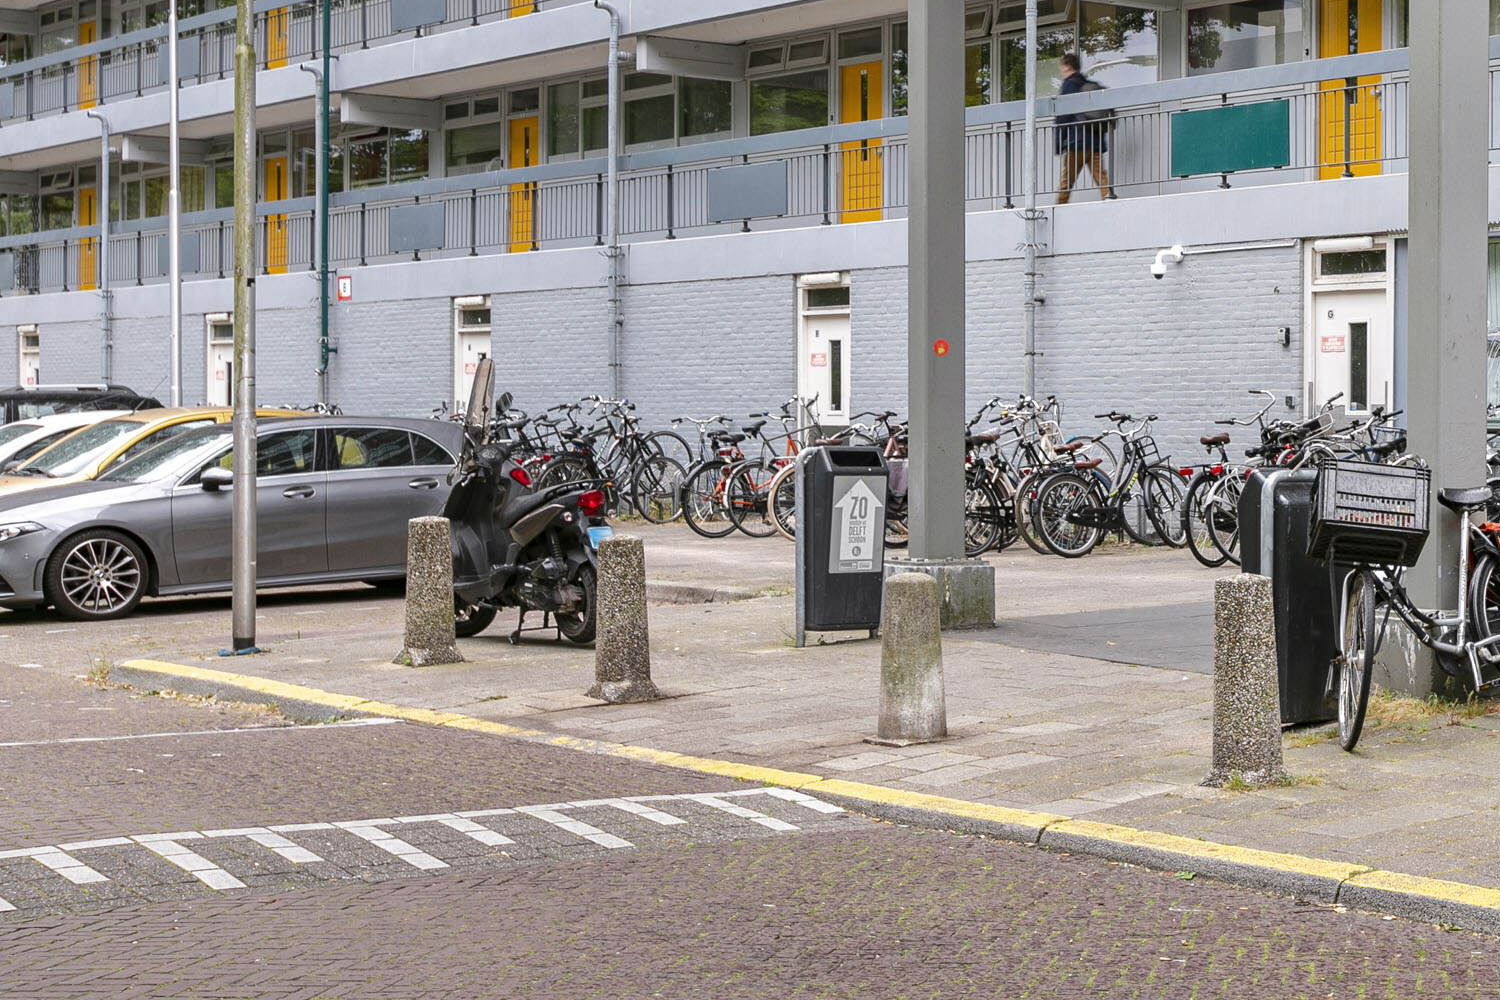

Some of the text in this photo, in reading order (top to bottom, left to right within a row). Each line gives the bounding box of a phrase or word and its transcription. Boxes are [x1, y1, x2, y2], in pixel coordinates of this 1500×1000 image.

[849, 496, 868, 520] ZO
[848, 526, 867, 536] DELFT
[848, 536, 866, 544] SCHOON
